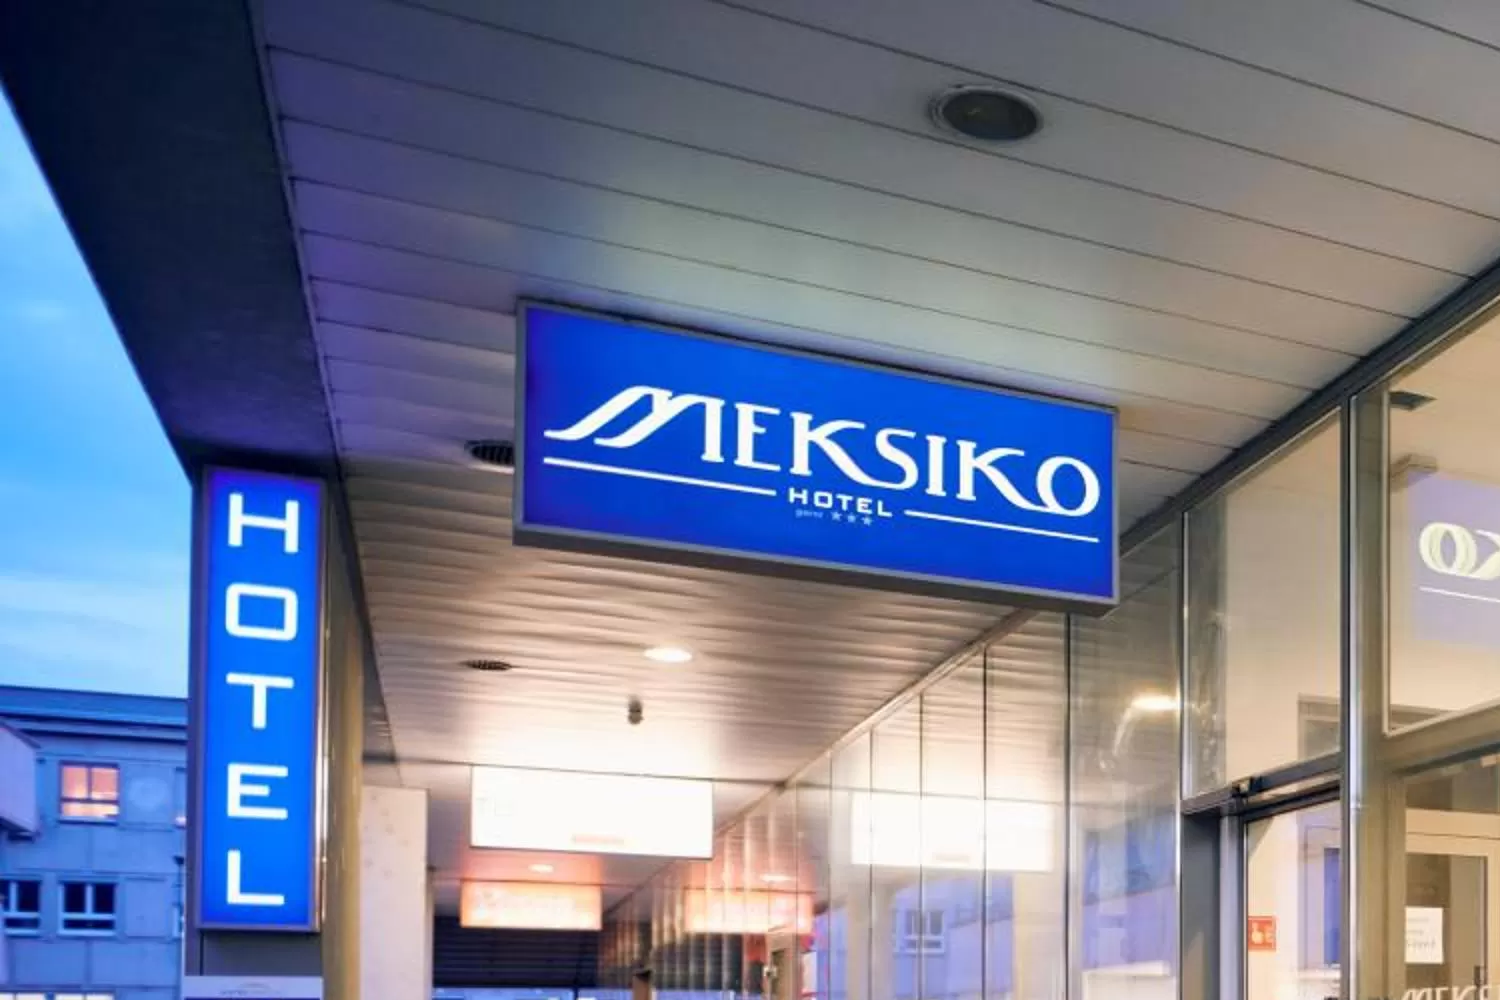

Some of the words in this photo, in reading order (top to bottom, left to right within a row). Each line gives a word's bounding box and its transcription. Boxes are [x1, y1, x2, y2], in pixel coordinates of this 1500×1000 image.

[543, 384, 1101, 518] MEKSIKO
[788, 487, 893, 517] HOTEL
[224, 492, 300, 906] HOTEL
